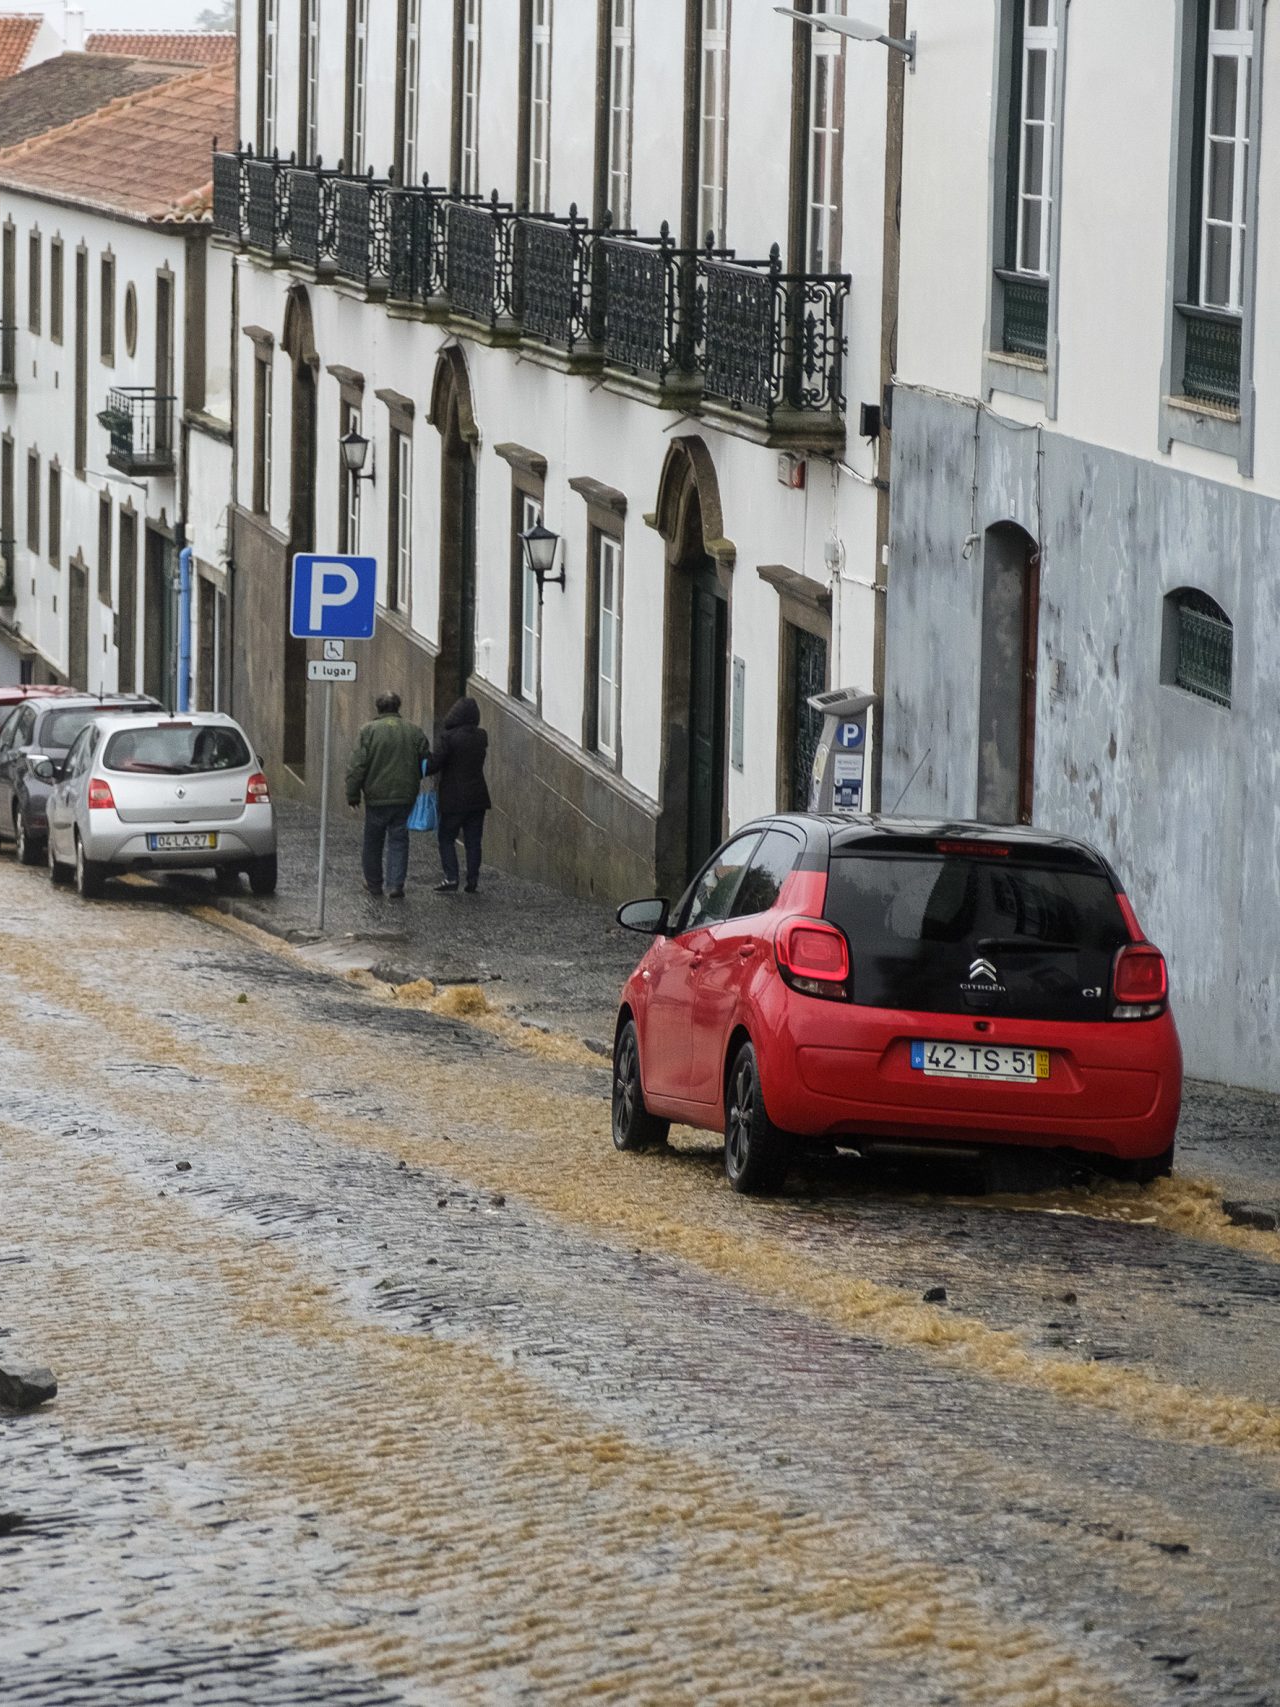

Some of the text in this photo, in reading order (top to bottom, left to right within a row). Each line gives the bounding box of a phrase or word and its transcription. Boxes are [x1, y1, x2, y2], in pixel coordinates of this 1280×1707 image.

[309, 562, 359, 631] P
[313, 665, 351, 677] 1 lugar
[842, 723, 859, 746] P
[1081, 986, 1102, 998] C1
[1040, 1053, 1048, 1062] 17
[1040, 1067, 1048, 1075] 10
